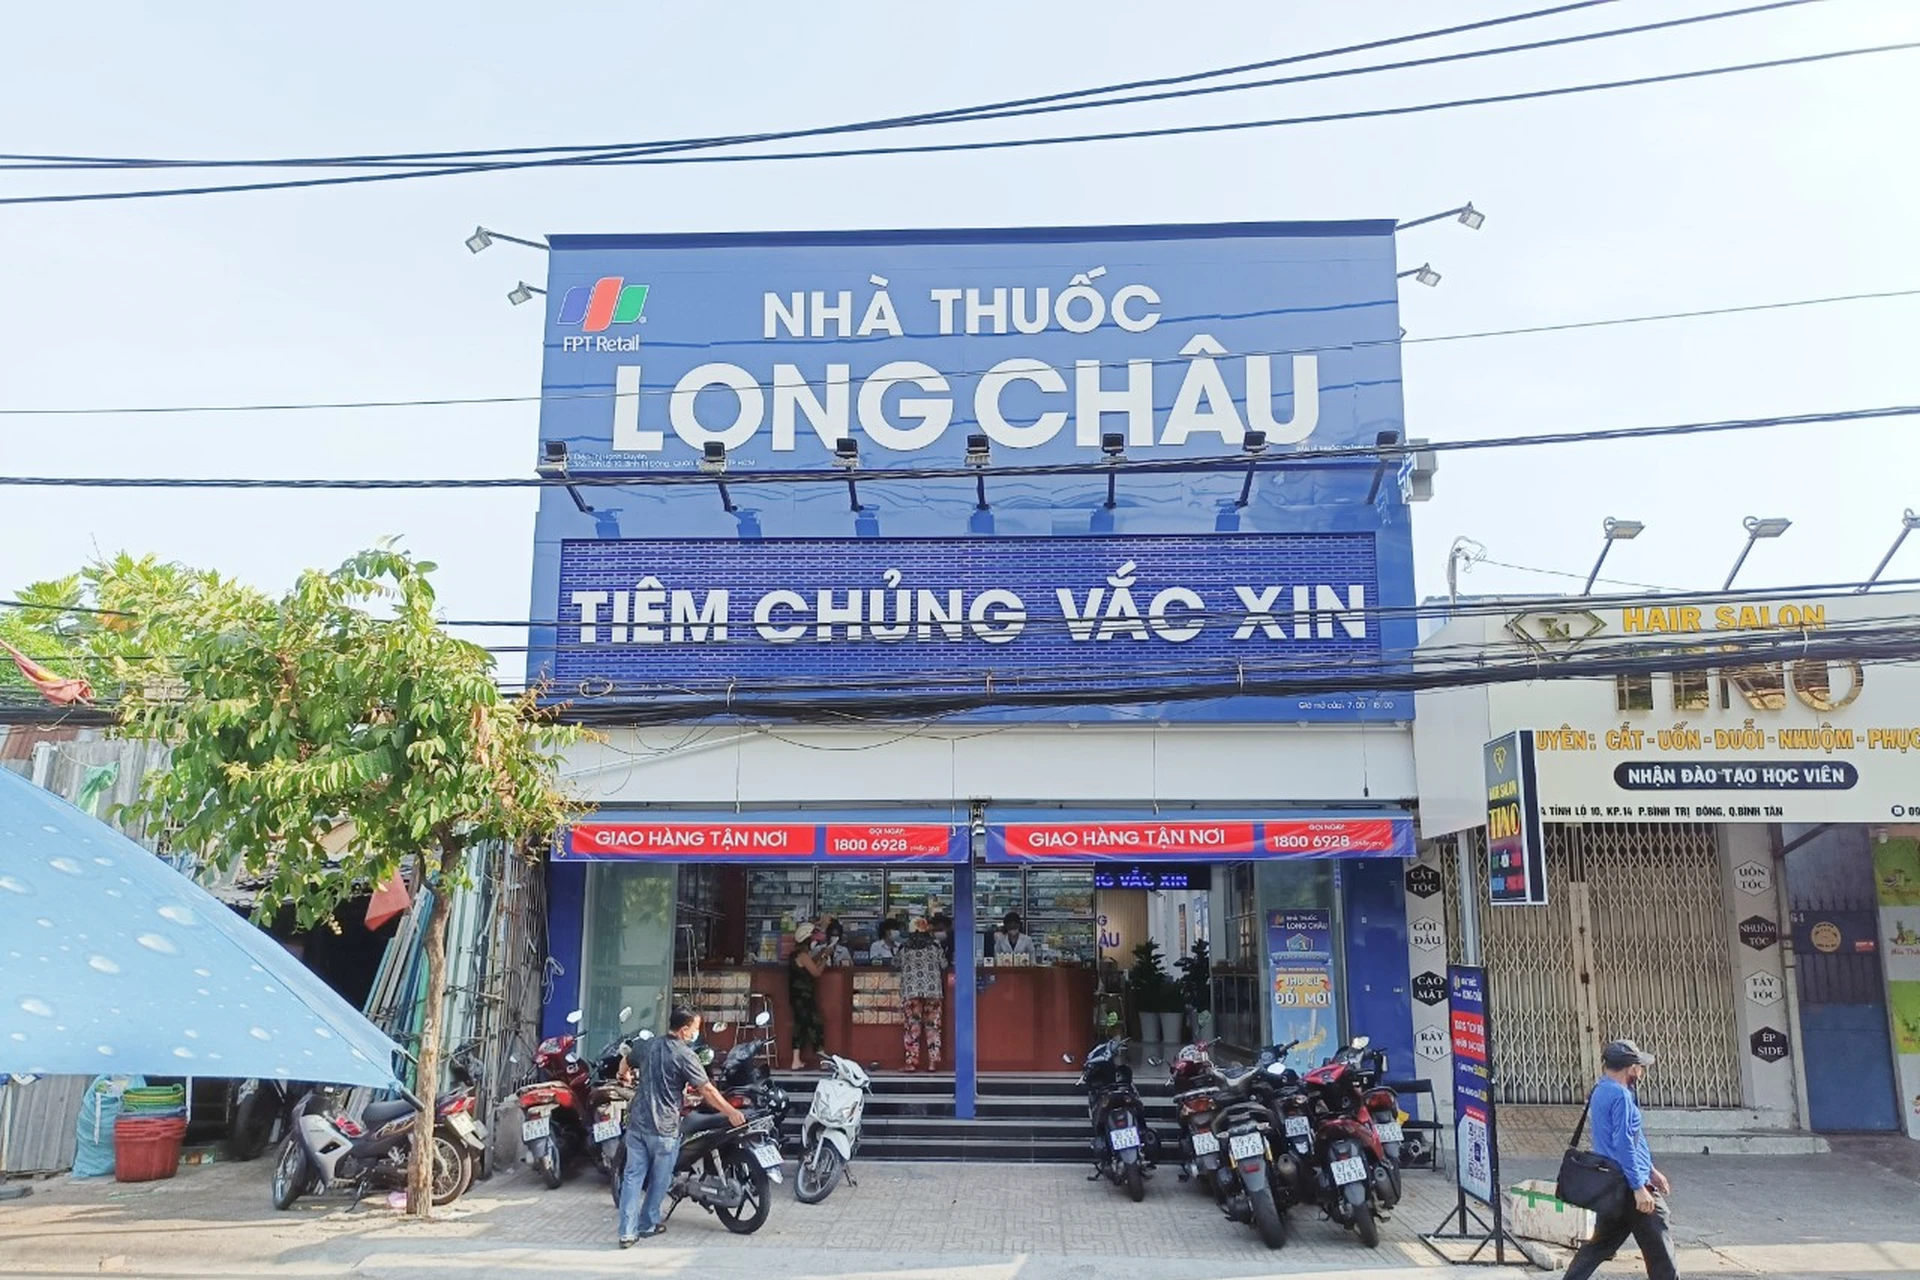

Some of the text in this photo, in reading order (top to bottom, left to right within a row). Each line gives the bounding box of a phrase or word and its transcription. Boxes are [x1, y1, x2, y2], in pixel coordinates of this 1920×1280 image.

[764, 265, 1162, 338] NHÀ THUỐC
[564, 334, 640, 352] FPT Retail
[612, 334, 1320, 452] LONG CHÂU
[571, 559, 1366, 644] TIÊM CHỦNG VẮC XIN
[1622, 604, 1826, 633] HAIR SALON
[1605, 721, 1644, 750] CẮT
[1657, 722, 1701, 750] UỐN
[1778, 724, 1855, 754] NHUỘM
[1628, 764, 1845, 788] NHẬN ĐÀO TẠO HỌC VIÊN
[1549, 804, 1572, 816] TỈNH
[1575, 804, 1588, 818] LỘ
[1606, 806, 1632, 816] KP.14
[1638, 804, 1670, 816] P.BÌNH
[1675, 806, 1691, 818] TRỊ
[1728, 804, 1761, 817] Q.BÌNH
[1766, 804, 1783, 816] TÂN
[1488, 802, 1521, 840] TINO
[868, 828, 882, 836] GỌI
[1028, 825, 1225, 850] GIAO HÀNG TẬN NƠI
[595, 826, 788, 852] GIAO HÀNG TẬN NƠI
[834, 838, 867, 851] 1800
[871, 838, 908, 851] 6928
[1273, 835, 1308, 848] 1800
[1313, 834, 1350, 847] 6928
[1119, 866, 1155, 887] VẮC
[1160, 872, 1187, 887] XIN
[1411, 869, 1433, 880] CẮT
[1412, 882, 1436, 892] TÓC
[1740, 878, 1766, 889] TÓC
[1286, 921, 1328, 930] LONG CHÂU
[1749, 935, 1770, 946] TÓC
[1286, 977, 1304, 986] THU
[1417, 976, 1443, 987] CẠO
[1275, 986, 1332, 1005] ĐỔI MỚI
[1417, 988, 1445, 1000] MẶT
[1753, 989, 1777, 999] TÓC
[1762, 1031, 1776, 1043] ÉP
[1424, 1045, 1443, 1055] TAI
[1757, 1046, 1784, 1056] SIDE
